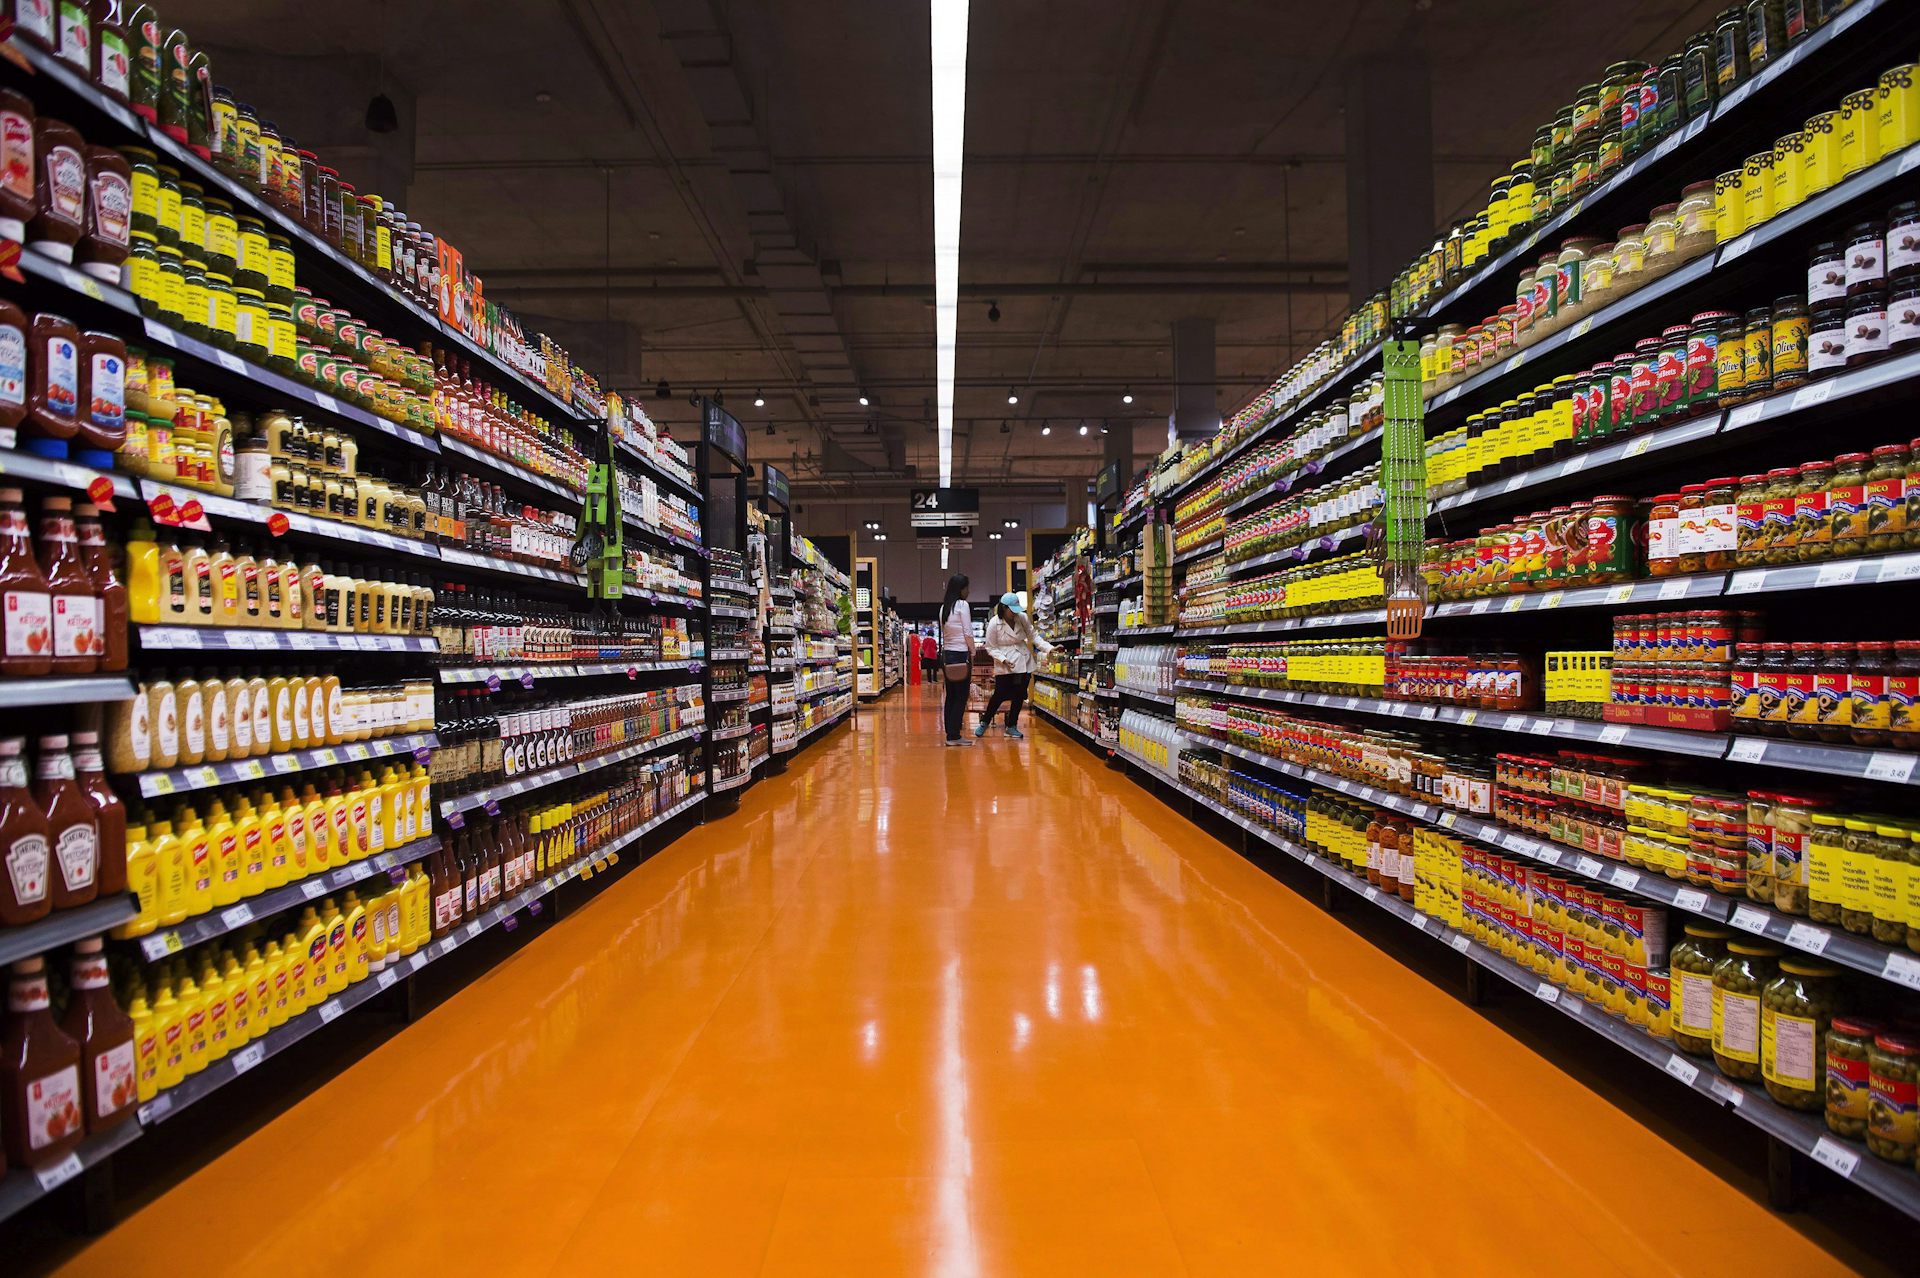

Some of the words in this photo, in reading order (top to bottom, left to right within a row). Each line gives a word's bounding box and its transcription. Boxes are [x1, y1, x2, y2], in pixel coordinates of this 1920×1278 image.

[914, 492, 938, 508] 24
[1737, 508, 1752, 516] nico
[1732, 674, 1744, 682] nico
[1759, 675, 1777, 684] nico
[1787, 676, 1802, 685] nico
[1817, 676, 1835, 685] nico
[1852, 678, 1870, 688] nico
[1890, 679, 1906, 689] nico
[1615, 707, 1630, 717] Unico
[1668, 711, 1687, 722] Unico
[1566, 889, 1584, 900] nico
[1584, 895, 1603, 906] nico
[1603, 902, 1625, 914] nico
[1584, 951, 1603, 962] nico
[1603, 960, 1621, 972] nico
[1625, 969, 1642, 981] nico
[1647, 979, 1666, 992] nico
